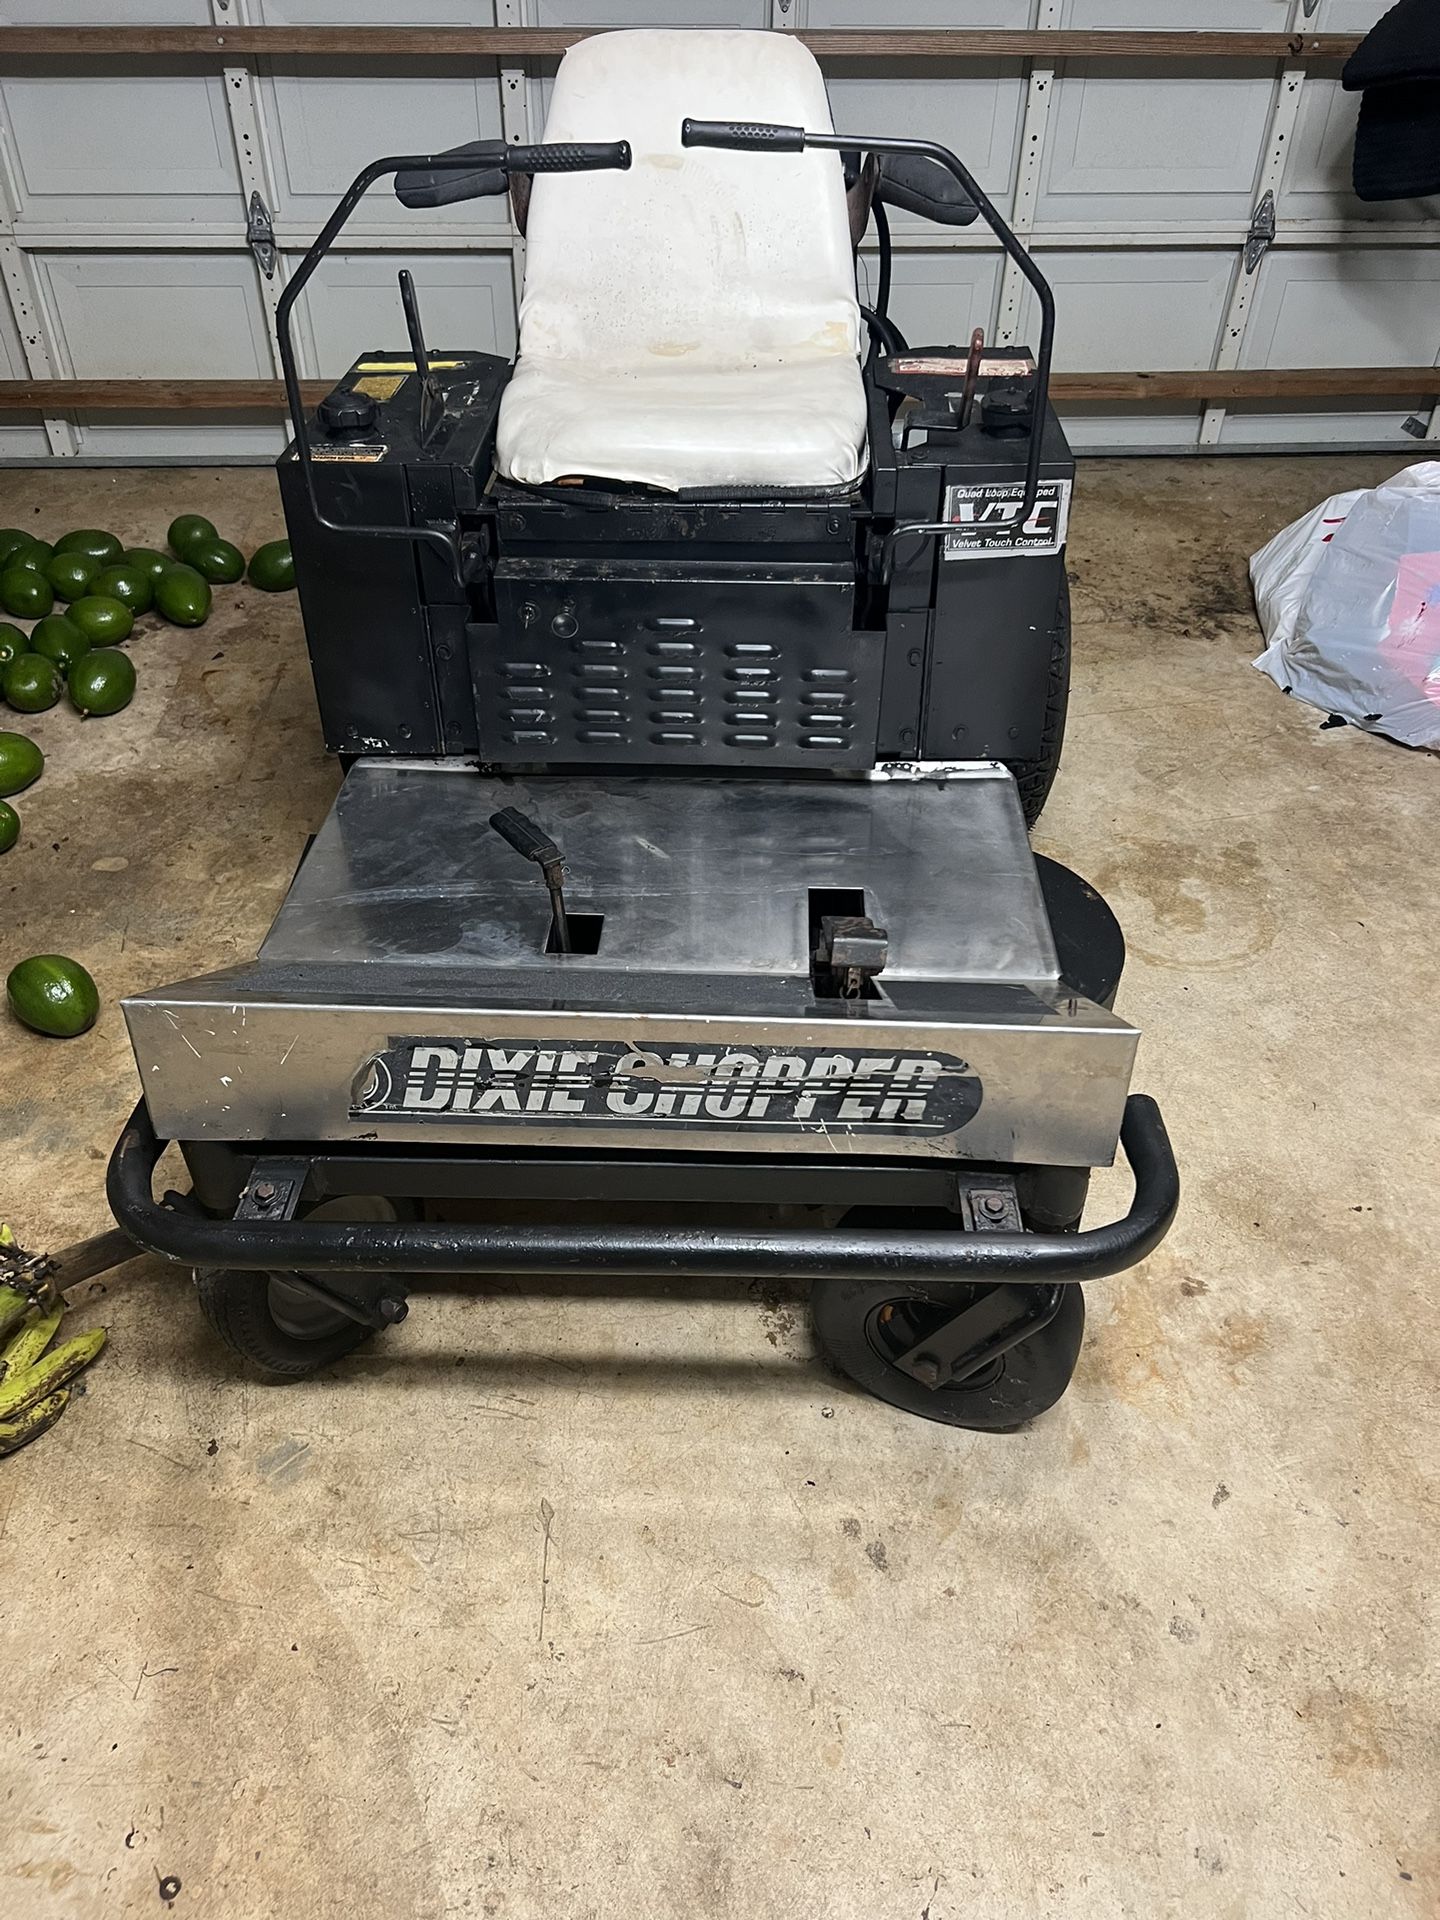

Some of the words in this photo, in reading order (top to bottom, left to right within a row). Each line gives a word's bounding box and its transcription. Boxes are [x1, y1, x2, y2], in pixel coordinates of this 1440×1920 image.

[957, 488, 983, 498] Quad
[985, 488, 1008, 499] Loop
[1011, 487, 1056, 499] Eqped
[952, 539, 982, 548] Velvet
[984, 538, 1012, 547] Touch
[403, 1046, 599, 1112] DIXIE
